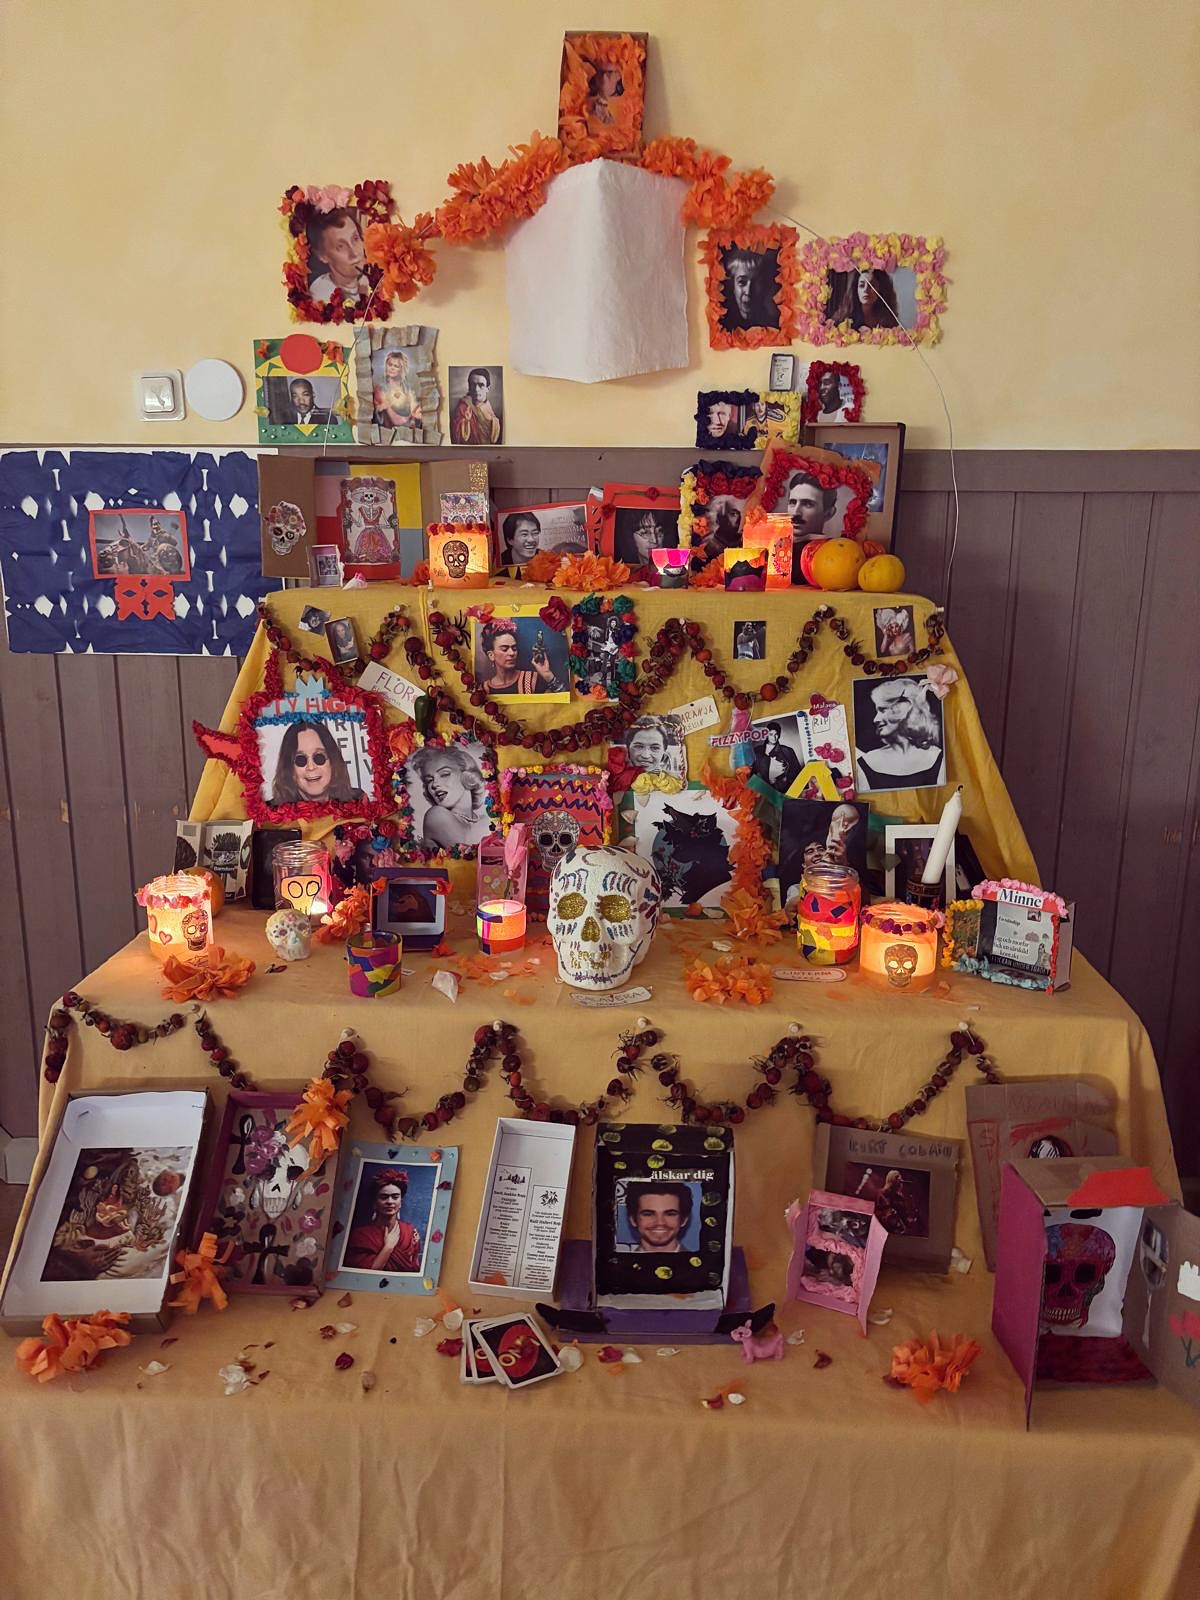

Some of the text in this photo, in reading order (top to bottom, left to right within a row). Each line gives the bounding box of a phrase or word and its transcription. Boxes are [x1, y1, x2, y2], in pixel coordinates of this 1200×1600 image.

[680, 704, 715, 723] ARANJA
[813, 717, 829, 727] RIP
[711, 729, 769, 747] FIZZYPOP
[1000, 888, 1042, 908] Minne
[651, 1170, 715, 1182] älskar dig
